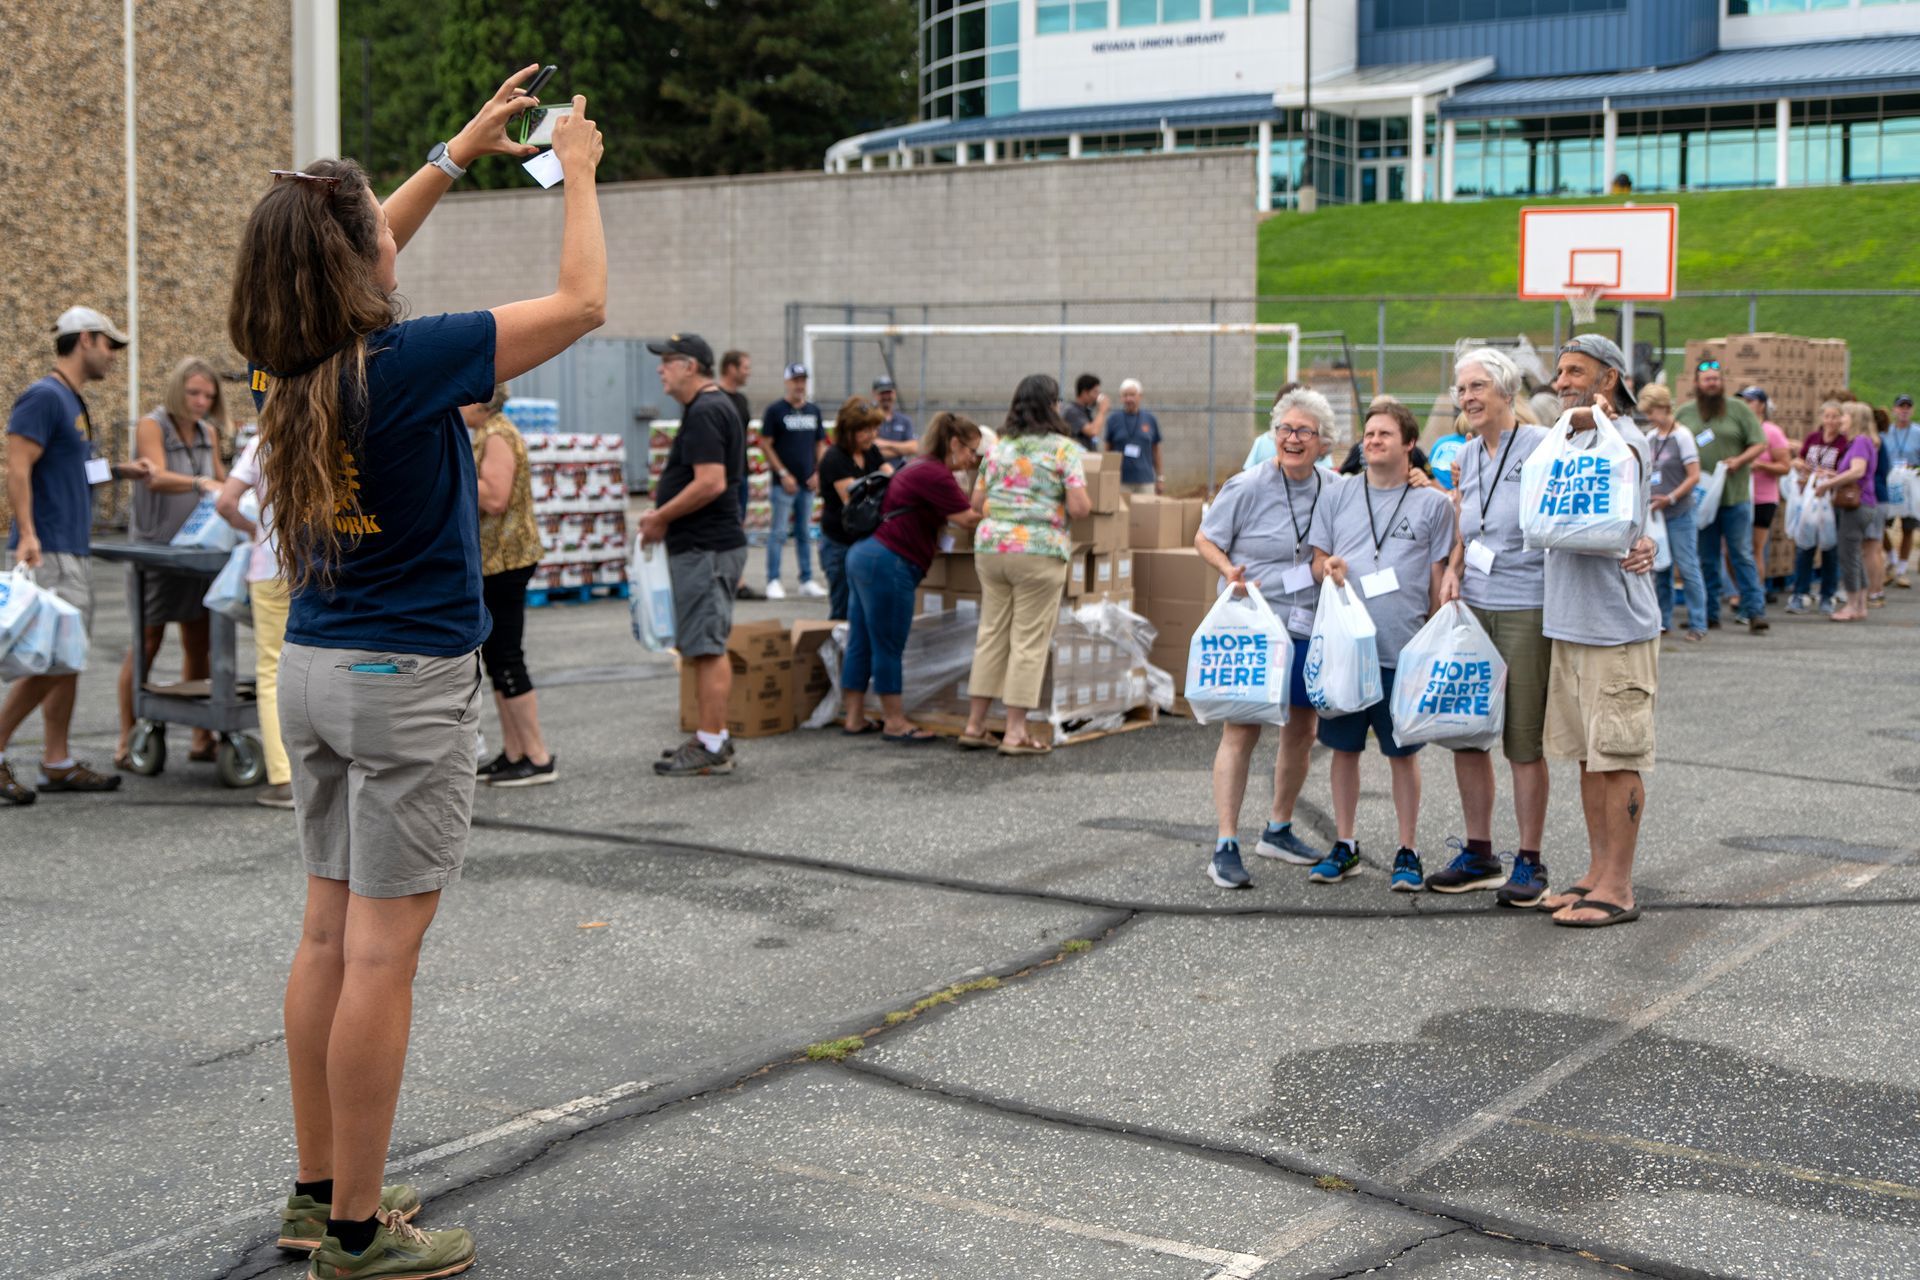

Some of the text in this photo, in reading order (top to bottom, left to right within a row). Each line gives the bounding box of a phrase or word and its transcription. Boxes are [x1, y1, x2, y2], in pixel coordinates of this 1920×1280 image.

[1092, 32, 1225, 52] NEVADA UNION LIBRARY
[1546, 477, 1610, 494] STARTS
[1538, 494, 1610, 517] HERE
[1201, 634, 1267, 651] HOPE
[1201, 653, 1267, 666] STARTS
[1199, 668, 1266, 686] HERE
[1430, 661, 1491, 681] HOPE
[1427, 681, 1490, 695] STARTS
[1418, 695, 1489, 716] HERE
